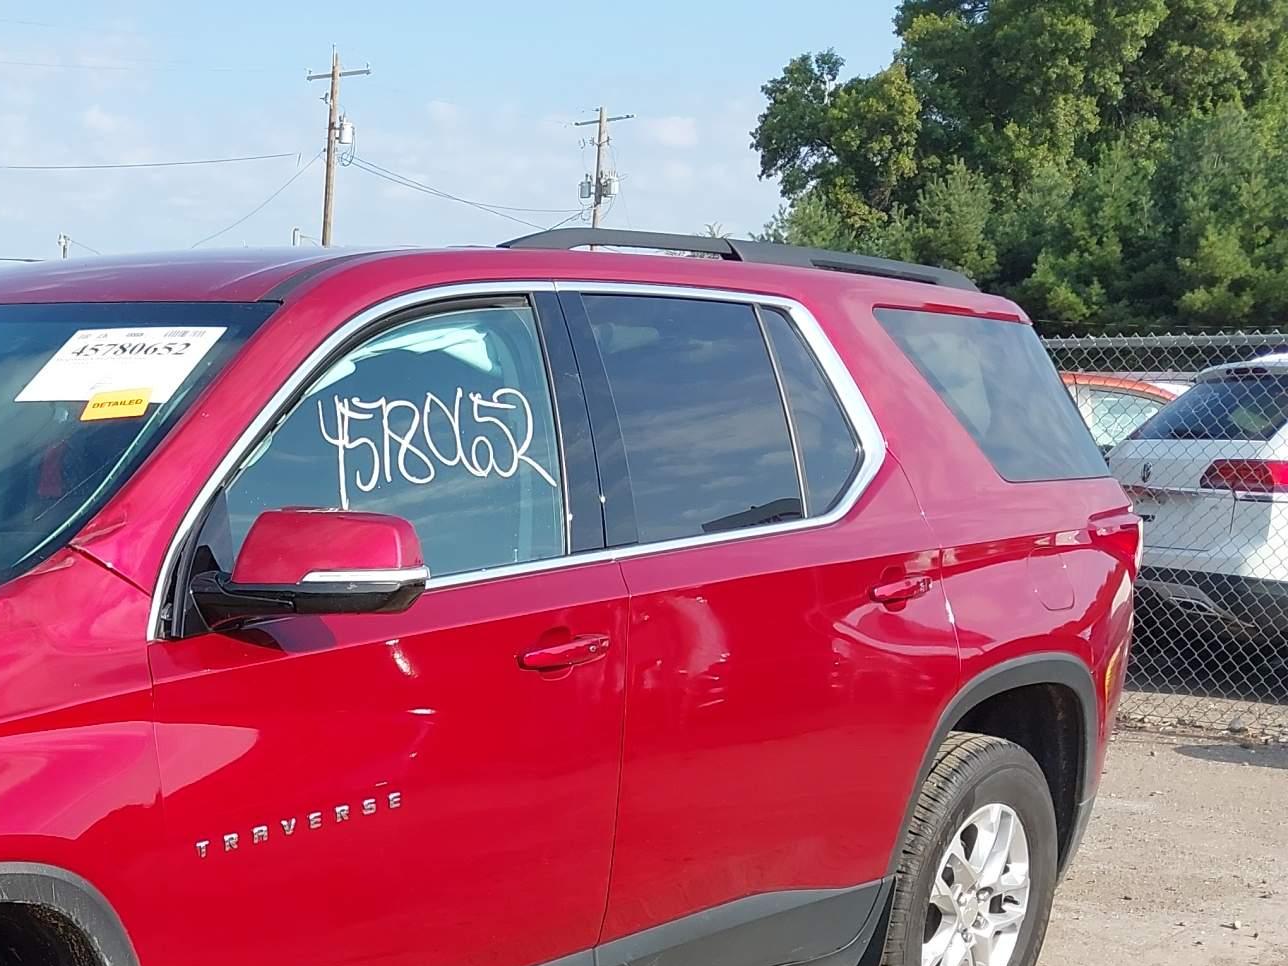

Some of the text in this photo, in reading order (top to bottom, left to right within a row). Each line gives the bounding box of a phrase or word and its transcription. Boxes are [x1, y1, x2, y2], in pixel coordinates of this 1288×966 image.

[72, 342, 191, 357] 45780652
[92, 398, 143, 409] DETAILED
[318, 387, 557, 510] 45780652
[196, 792, 401, 858] TRAVERSE
